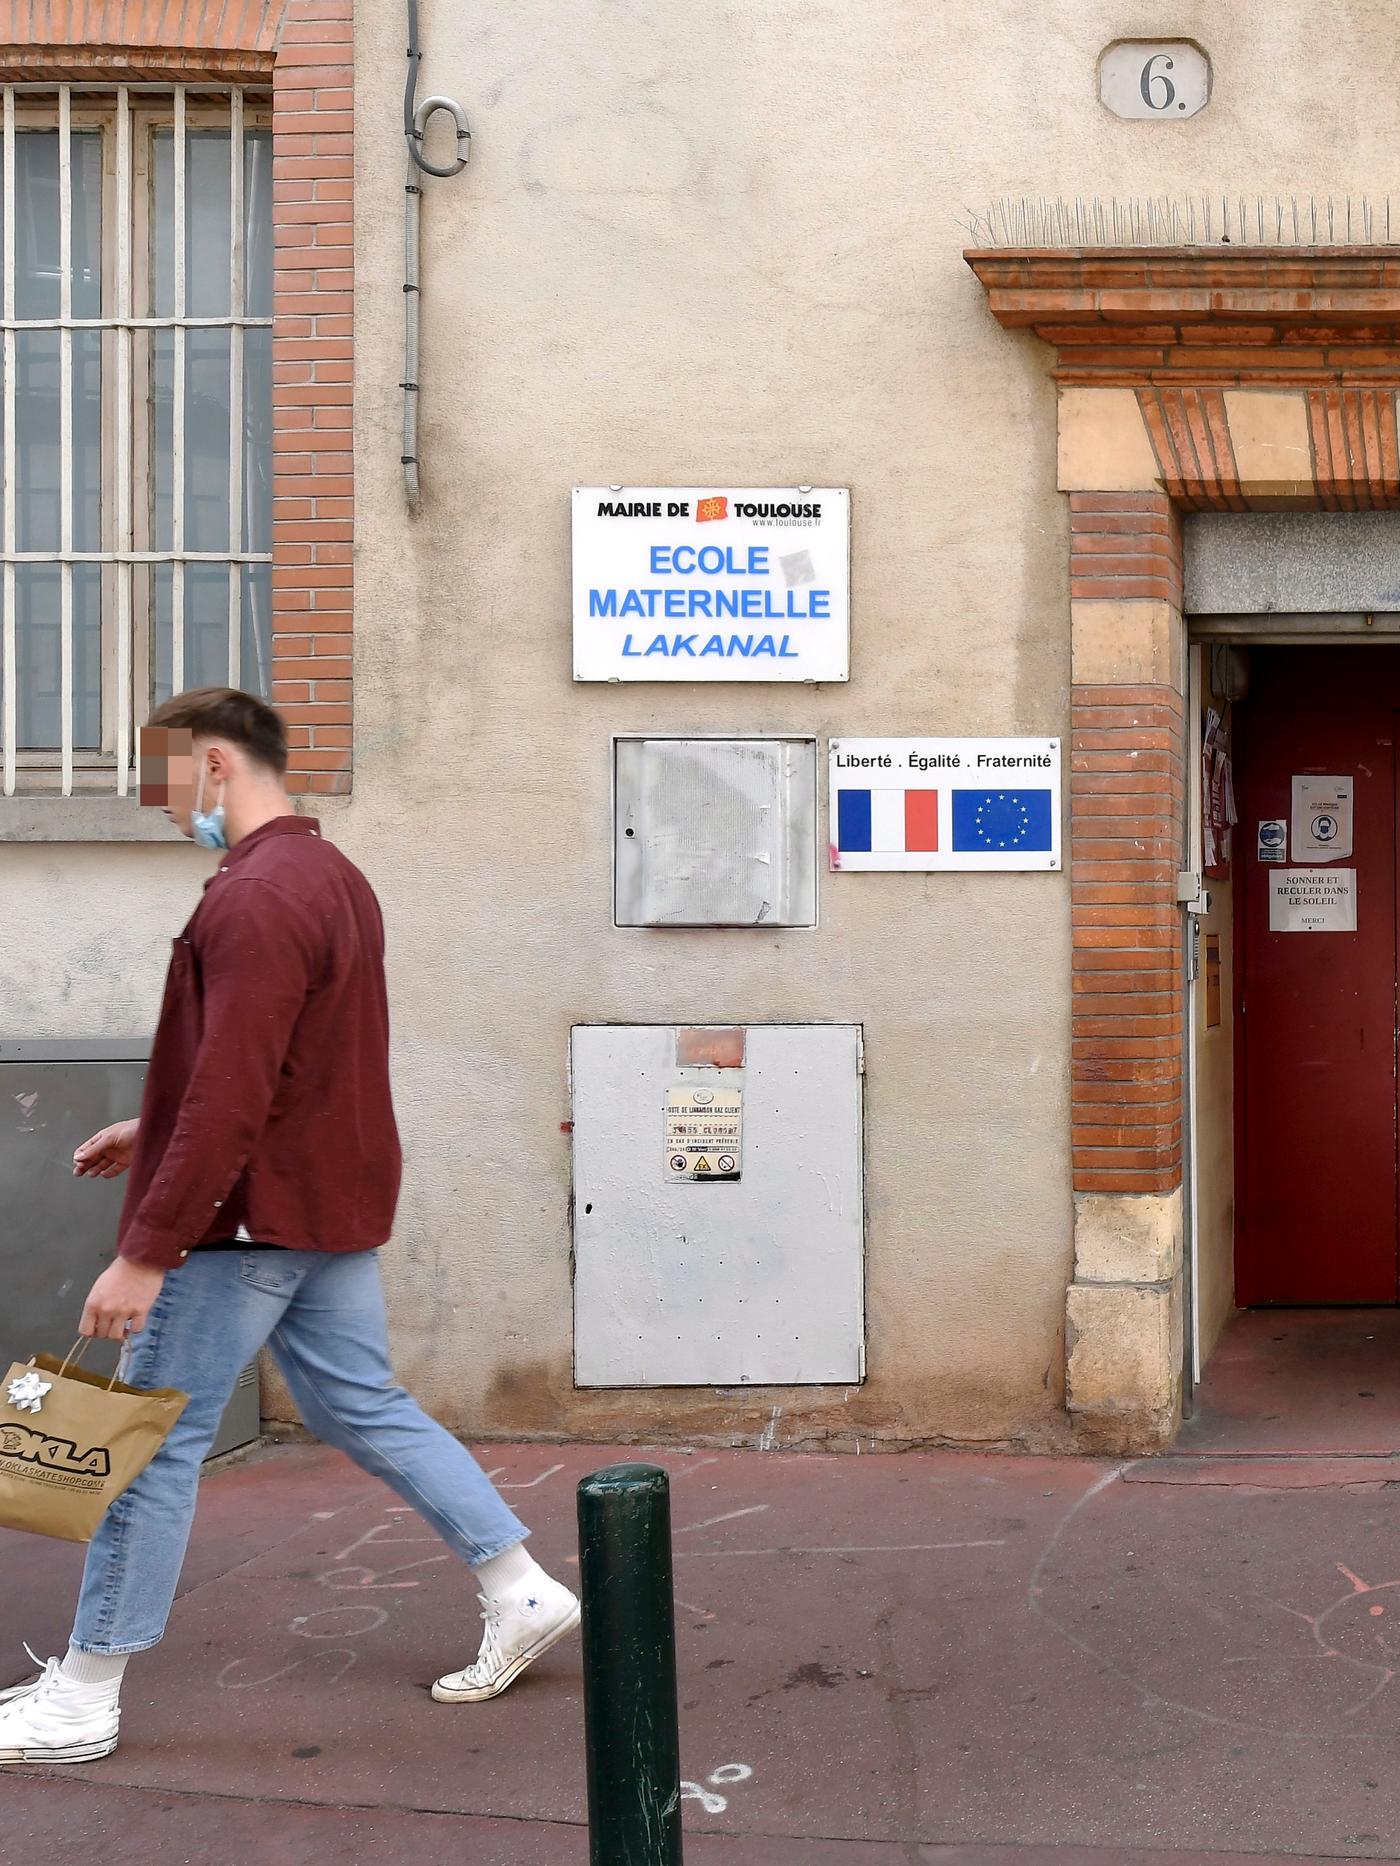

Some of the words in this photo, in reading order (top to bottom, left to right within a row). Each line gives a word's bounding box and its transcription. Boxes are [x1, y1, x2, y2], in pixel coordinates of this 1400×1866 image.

[597, 502, 662, 517] MAIRIE
[667, 502, 689, 517] DE
[734, 503, 822, 518] TOULOUSE
[650, 545, 770, 575] ECOLE
[589, 589, 831, 618] MATERNELLE
[621, 634, 799, 657] LAKANAL
[836, 754, 892, 768] Liberté
[908, 751, 961, 771] Égalité
[977, 754, 1052, 768] Fraternité
[1286, 877, 1324, 885] SONNER
[1277, 887, 1321, 895] RECULER
[1324, 887, 1349, 895] DANS
[1289, 897, 1301, 905] LE
[1303, 897, 1337, 905] SOLEIL
